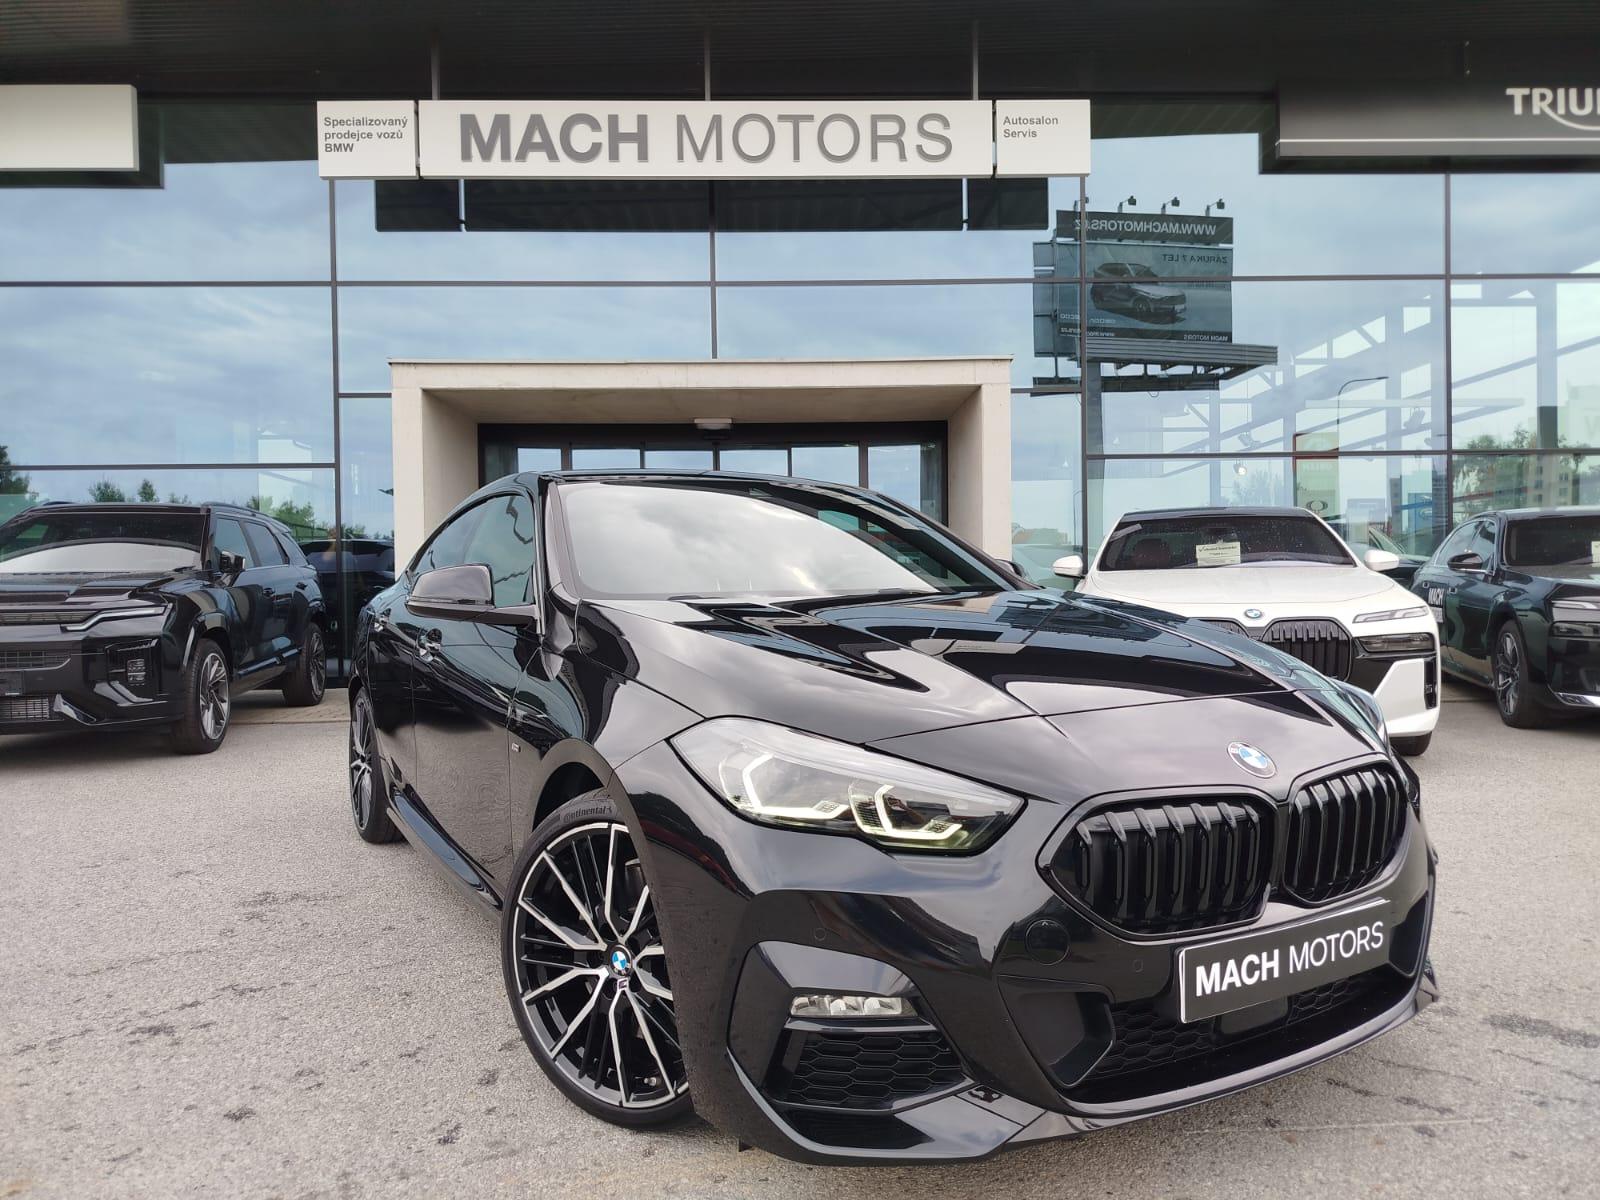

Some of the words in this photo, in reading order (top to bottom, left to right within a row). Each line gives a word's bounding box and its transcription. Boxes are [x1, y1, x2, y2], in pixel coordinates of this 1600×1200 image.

[1505, 87, 1600, 131] TRIU
[323, 116, 408, 129] Specializovaný
[1003, 115, 1059, 126] Autosalon
[324, 130, 374, 142] prodejce
[376, 129, 404, 140] vozů
[459, 112, 650, 163] MACH
[675, 112, 954, 164] MOTORS
[1003, 128, 1038, 138] Servis
[324, 142, 355, 153] BMW
[1195, 948, 1280, 997] MACH
[1288, 921, 1385, 974] MOTORS
